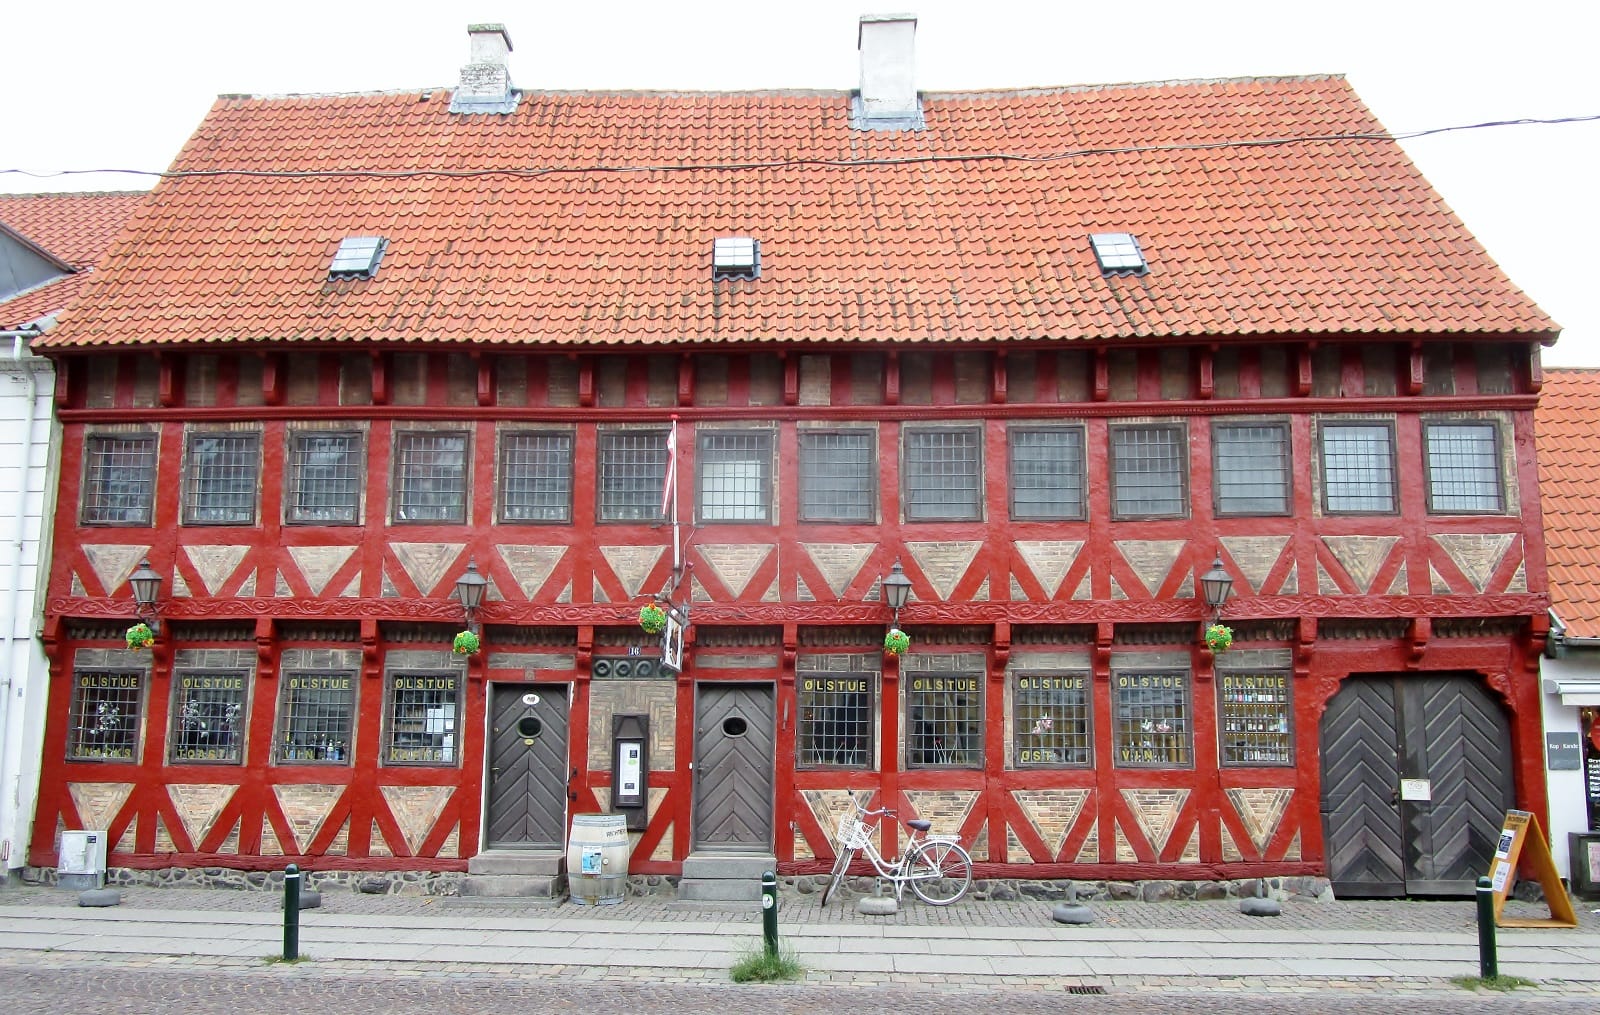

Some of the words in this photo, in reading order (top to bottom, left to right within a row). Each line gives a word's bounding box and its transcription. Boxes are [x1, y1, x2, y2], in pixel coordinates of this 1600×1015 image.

[630, 647, 640, 656] 16
[81, 677, 138, 688] ØLSTUE
[183, 678, 241, 689] ØLSTUE
[290, 678, 349, 690] ØLSTUE
[395, 678, 455, 690] ØLSTUE
[804, 679, 867, 692] ØLSTUE
[913, 679, 977, 691] ØLSTUE
[1020, 678, 1084, 690] ØLSTUE
[1119, 677, 1184, 688] ØLSTUE
[284, 750, 316, 760] VIN
[1121, 750, 1153, 761] VIN
